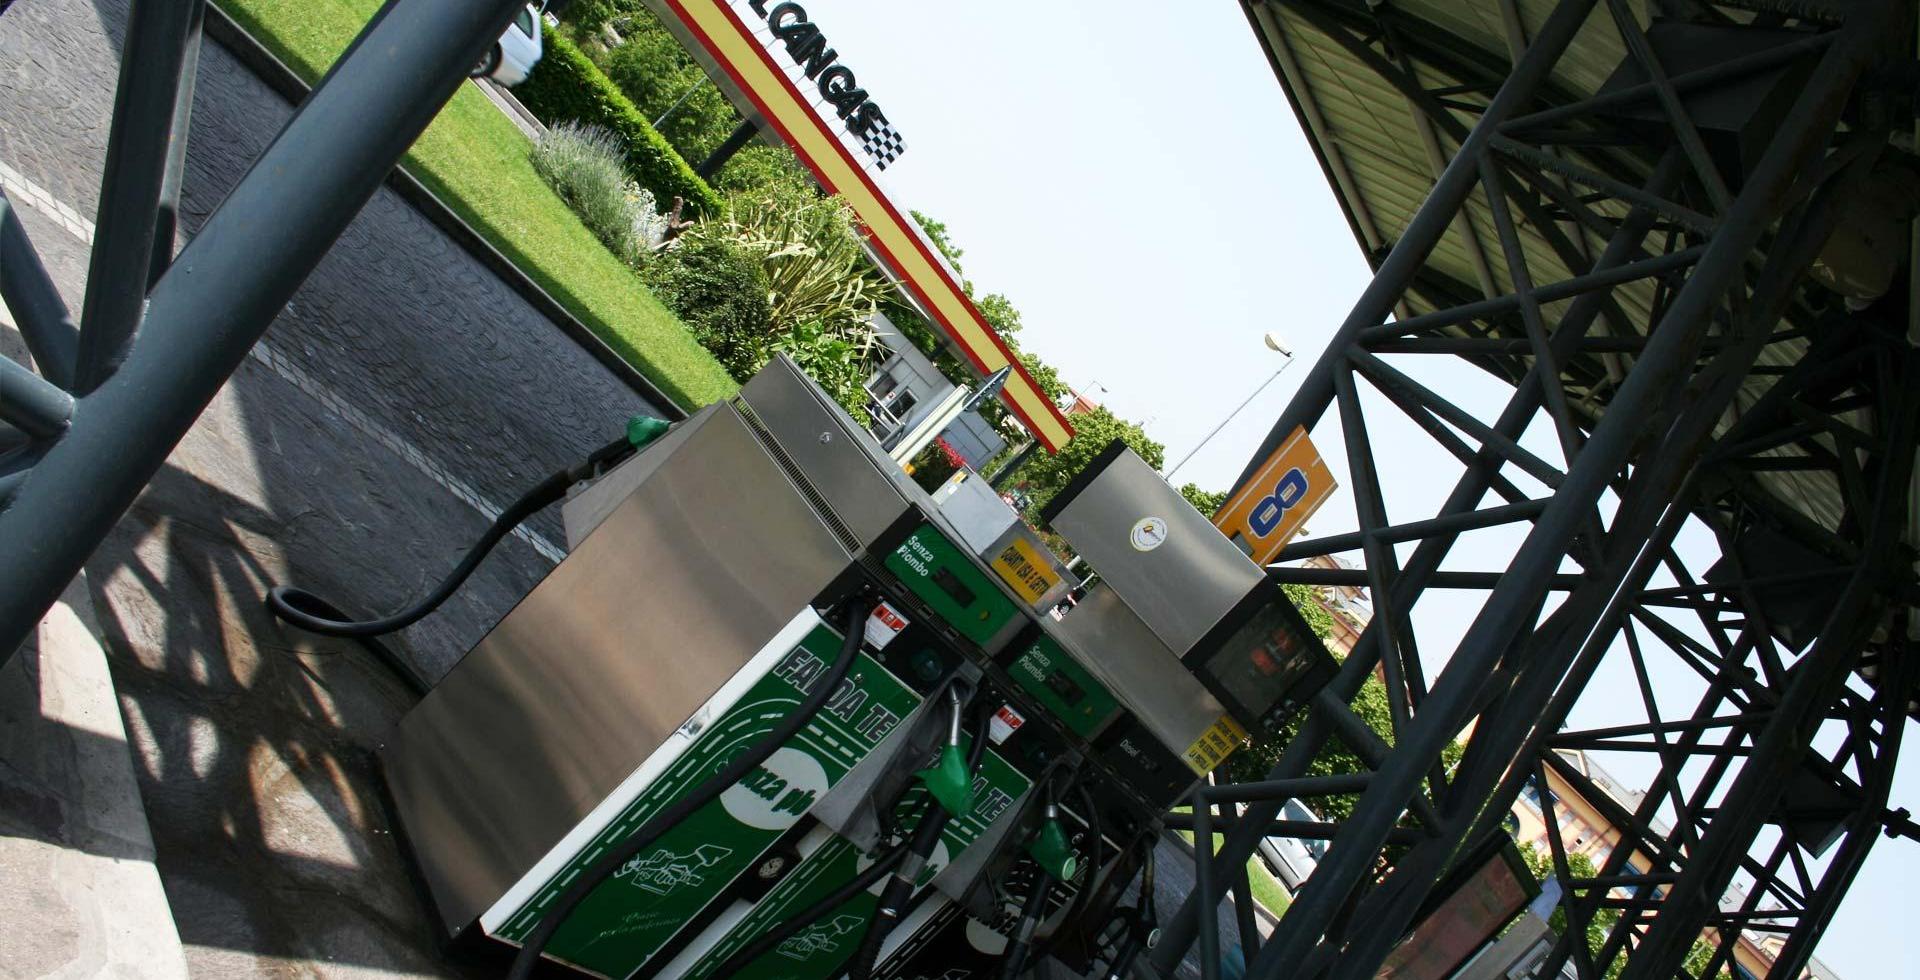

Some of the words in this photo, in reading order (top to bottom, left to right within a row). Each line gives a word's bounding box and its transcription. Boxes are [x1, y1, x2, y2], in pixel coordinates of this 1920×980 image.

[1246, 466, 1309, 539] 8
[897, 545, 929, 577] Piombo
[908, 535, 934, 562] Senza
[1019, 655, 1046, 682] Piombo
[1029, 645, 1051, 668] Senza
[854, 702, 901, 744] TE
